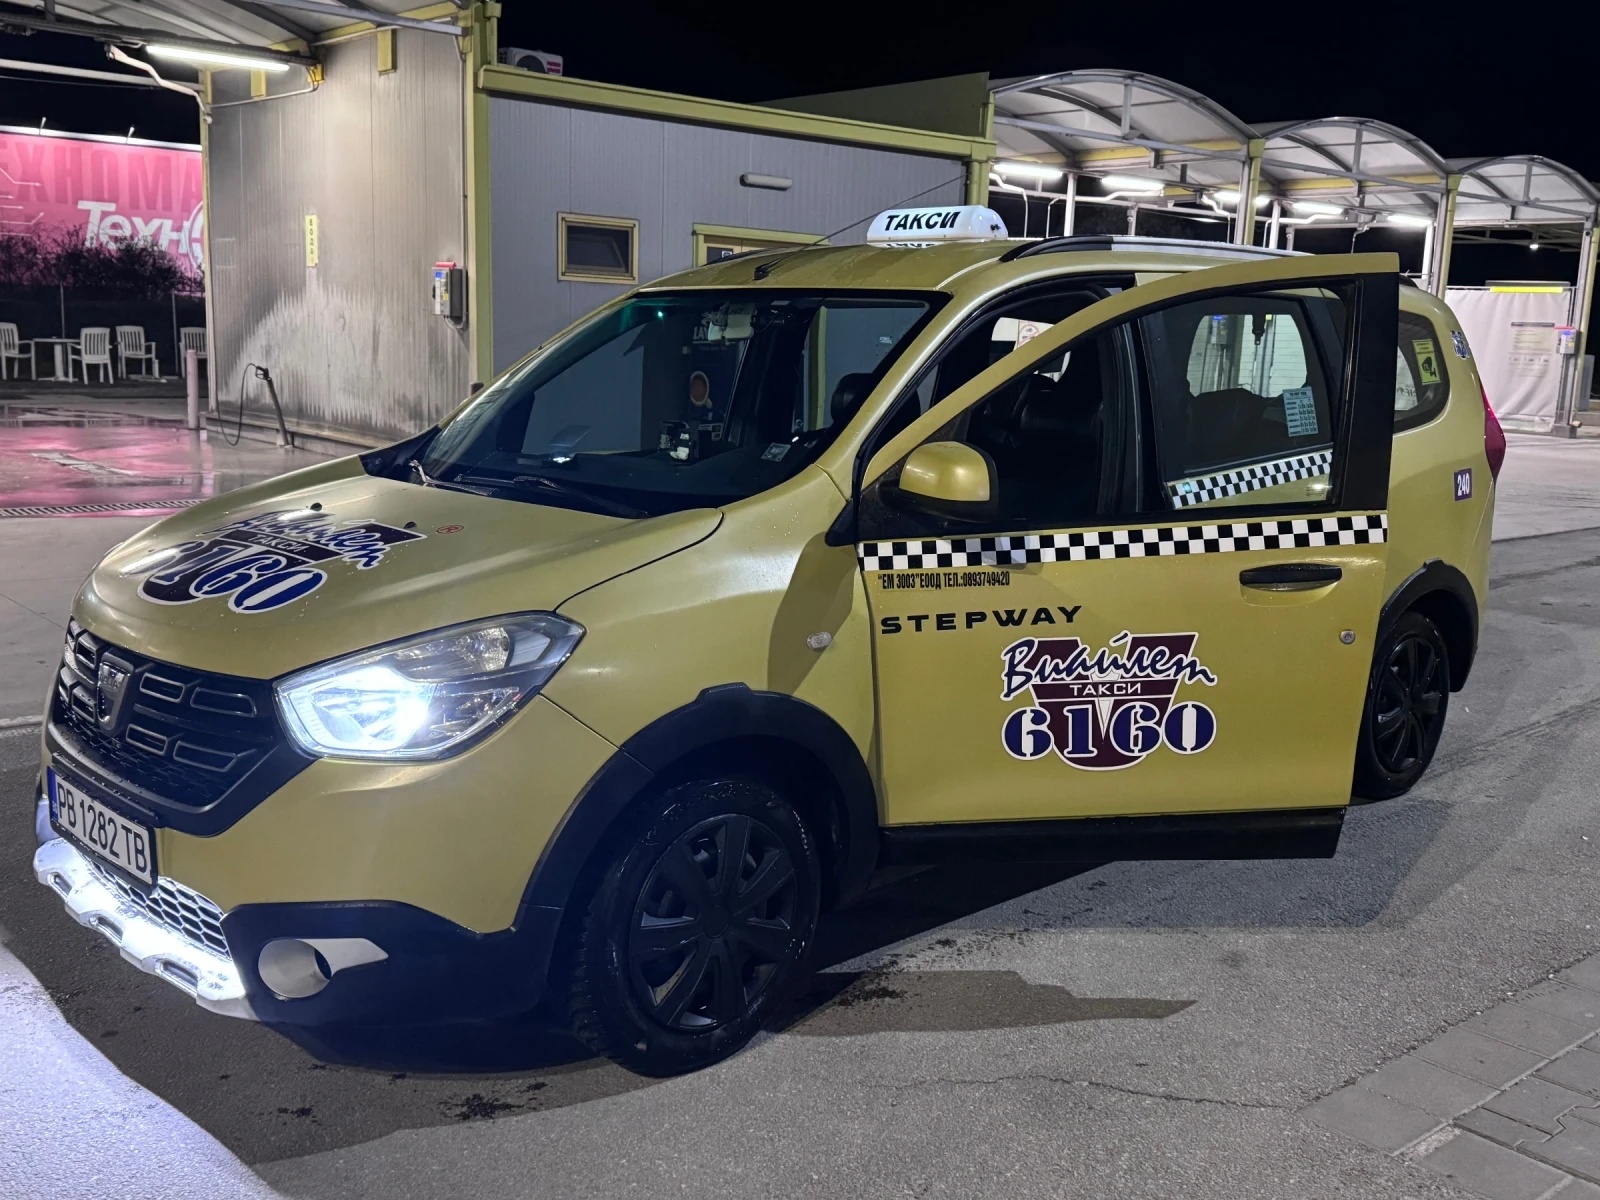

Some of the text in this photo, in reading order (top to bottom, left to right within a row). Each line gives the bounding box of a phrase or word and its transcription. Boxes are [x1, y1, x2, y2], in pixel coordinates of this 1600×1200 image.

[885, 211, 961, 231] ТАКСИ
[1457, 472, 1470, 497] 240
[248, 534, 309, 553] ТАКСИ
[121, 540, 328, 614] 6160
[881, 606, 1082, 634] STEPWAY
[1069, 682, 1141, 696] ТАКСИ
[1002, 702, 1217, 760] 6160
[57, 782, 147, 873] PB 1282 TB
